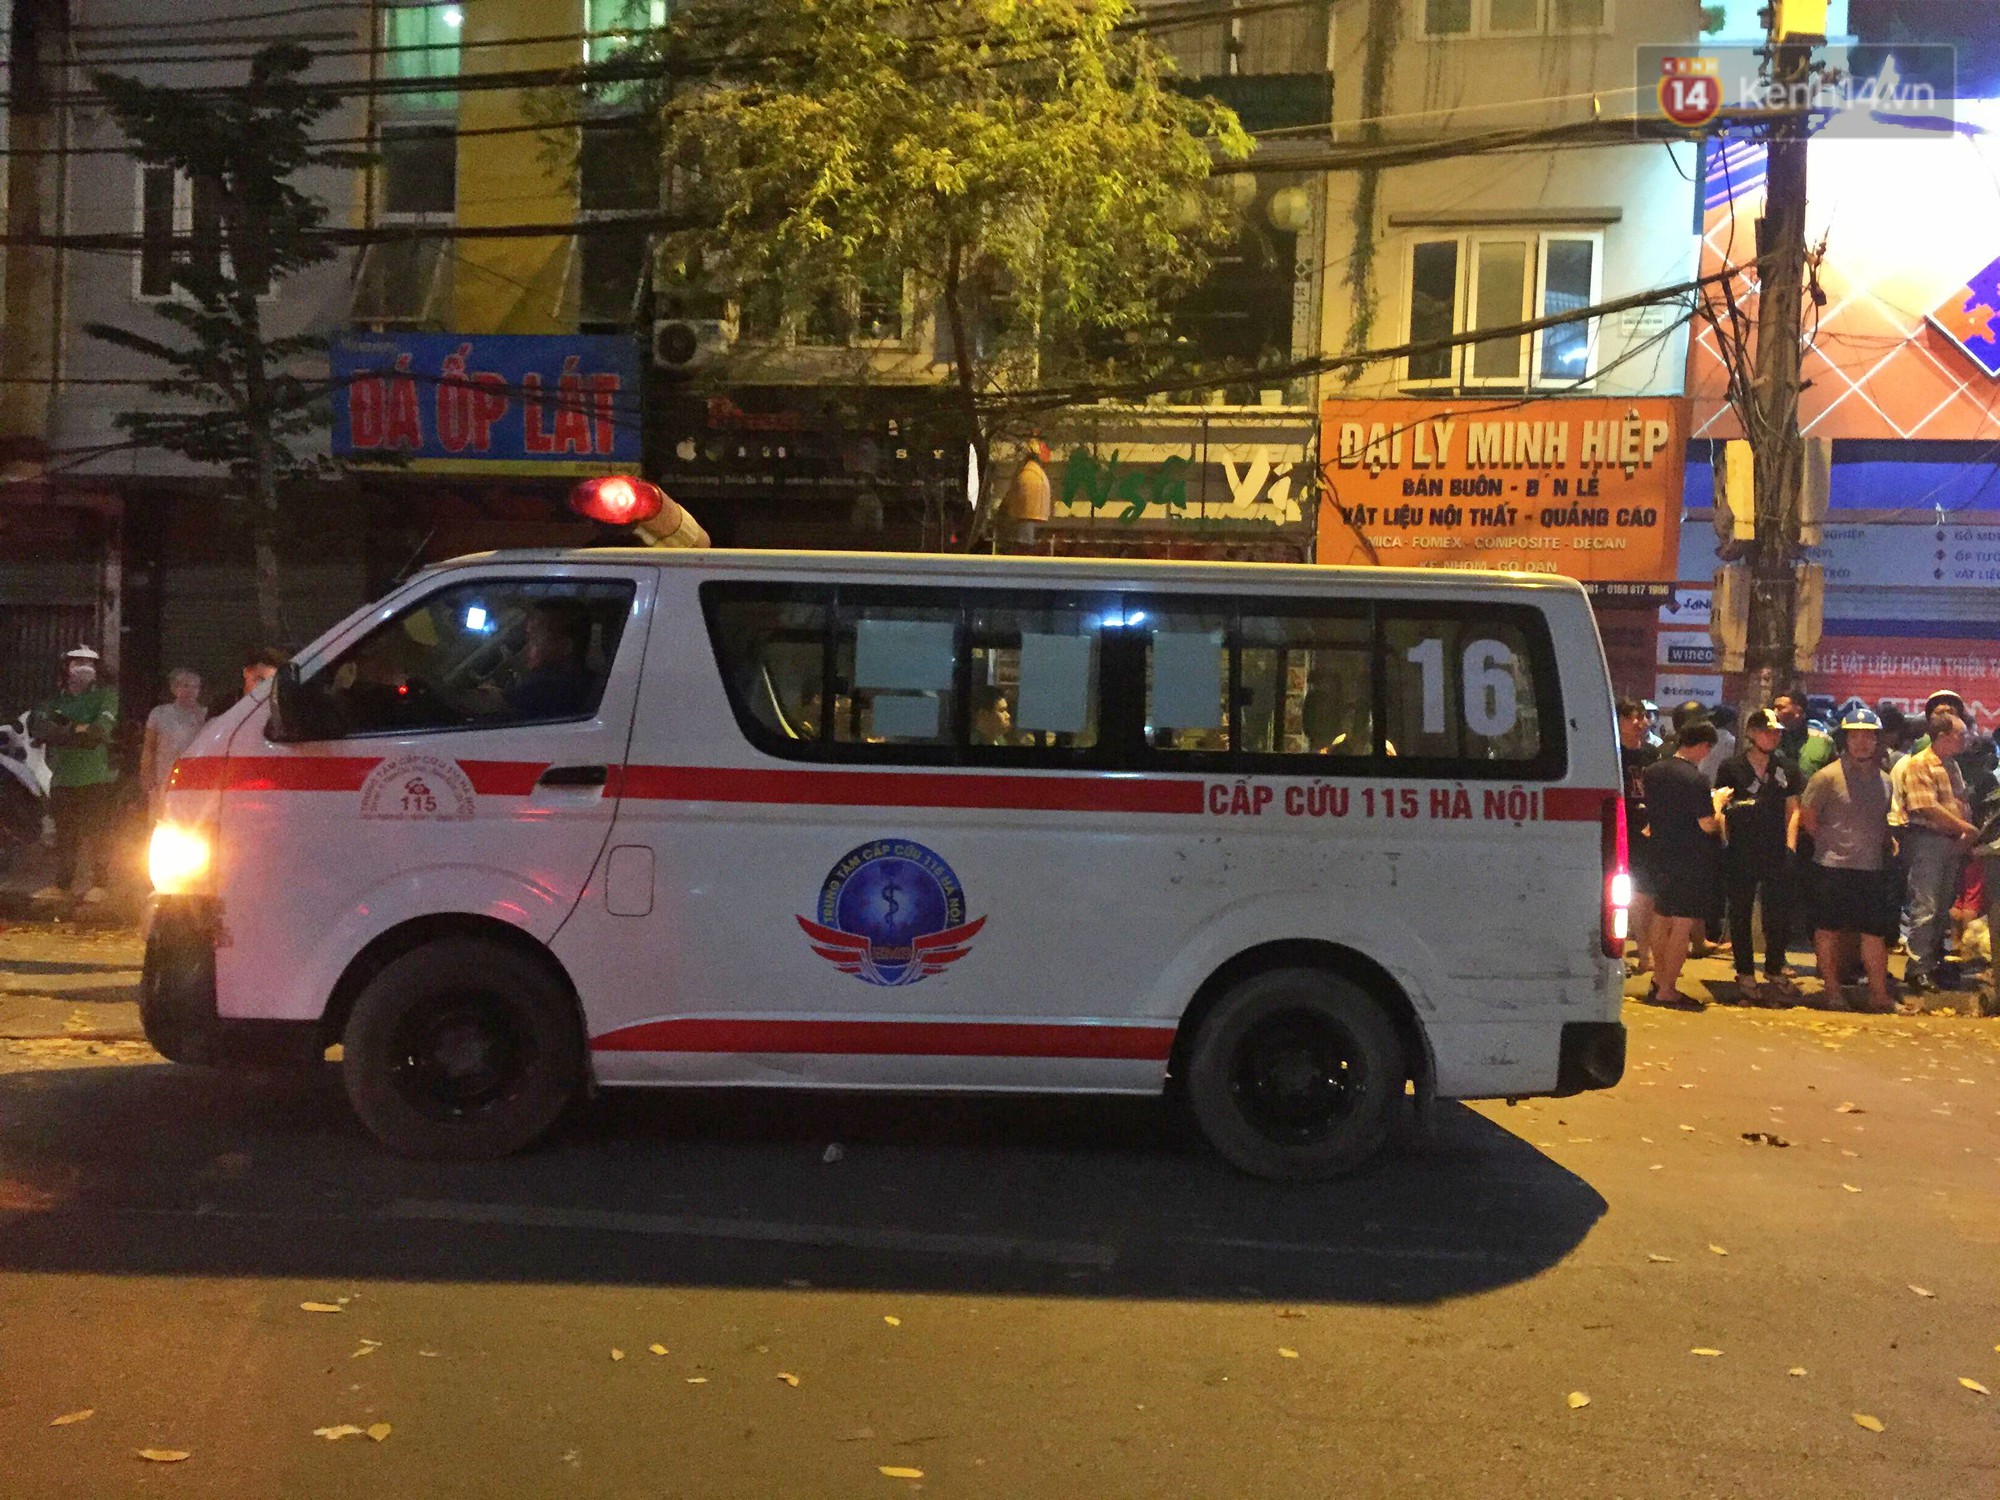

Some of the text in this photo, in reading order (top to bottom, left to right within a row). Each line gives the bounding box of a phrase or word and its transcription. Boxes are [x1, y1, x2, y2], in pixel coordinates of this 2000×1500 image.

[350, 343, 621, 456] ĐÁ ỐP LÁT
[1340, 407, 1669, 475] ĐẠI LÝ MINH HIỆP
[1403, 474, 1444, 497] BÁN
[1450, 474, 1503, 497] BUÔN
[1526, 473, 1568, 497] BN
[1383, 503, 1424, 531] LIỆU
[1429, 504, 1463, 531] NỘI
[1469, 500, 1518, 527] THẤT
[1540, 500, 1610, 527] QUẢNG
[1616, 504, 1658, 527] CÁO
[1367, 535, 1627, 549] MICA FOMEX COMPOSITE DECAN
[1406, 638, 1518, 737] 16
[400, 796, 438, 812] 115
[1208, 775, 1539, 828] CẤP CỨU 115 HÀ NỘI
